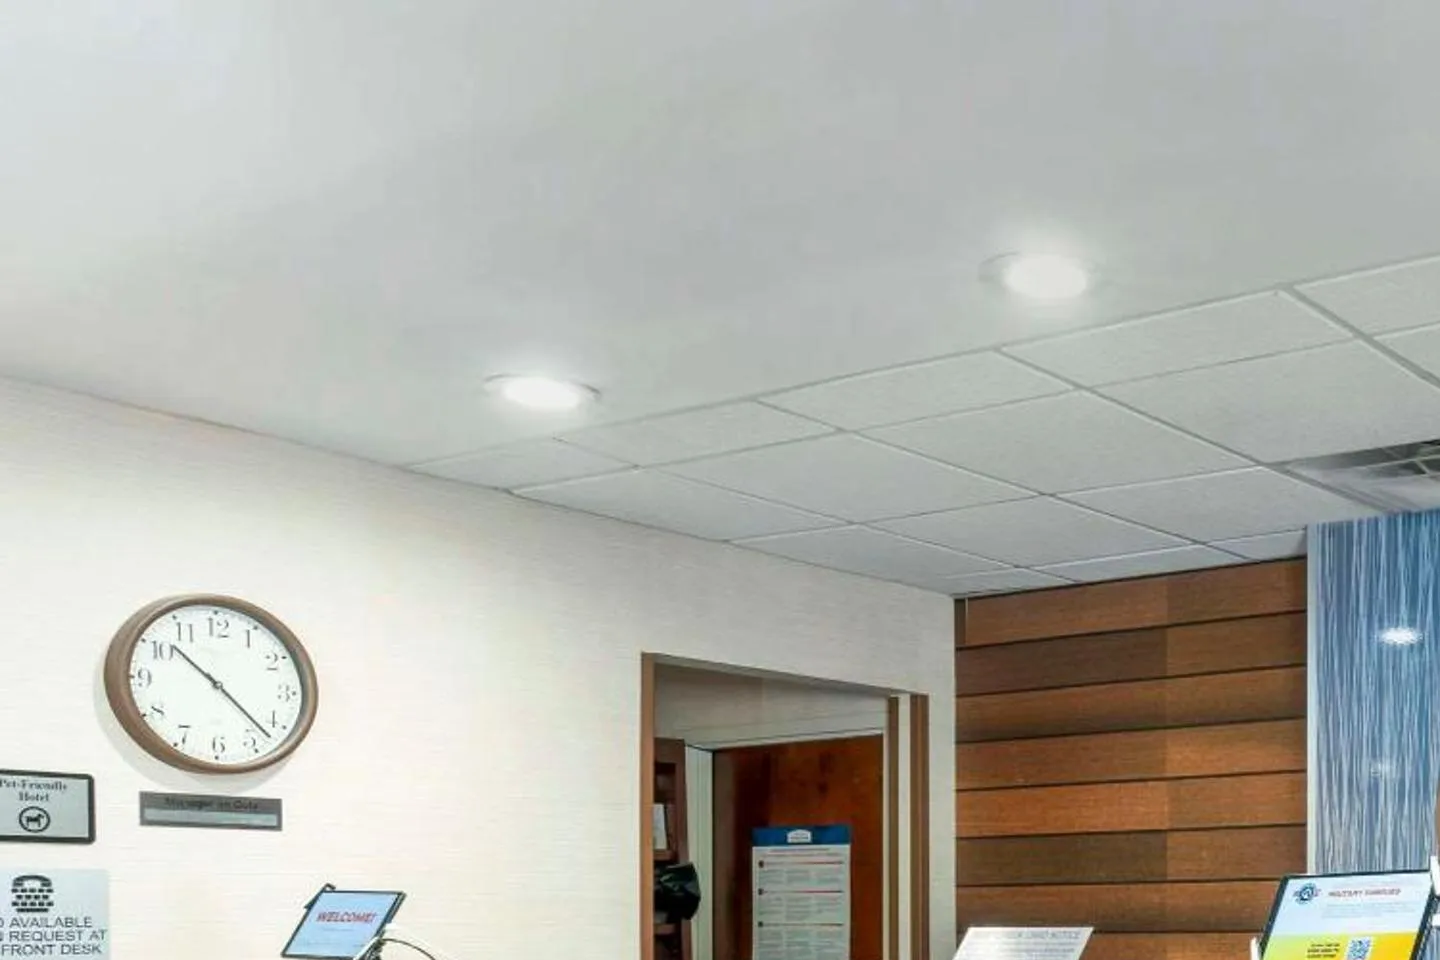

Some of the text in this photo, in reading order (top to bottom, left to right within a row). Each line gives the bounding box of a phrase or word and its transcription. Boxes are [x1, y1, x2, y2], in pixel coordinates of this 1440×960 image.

[177, 622, 194, 643] 11
[208, 617, 230, 638] 12
[245, 629, 251, 648] 1
[152, 641, 174, 661] 10
[265, 652, 279, 671] 2
[137, 667, 152, 688] 9
[277, 685, 291, 702] 3
[265, 710, 278, 728] 4
[178, 725, 192, 745] 7
[212, 736, 226, 753] 6
[18, 791, 51, 802] Hotel
[9, 916, 93, 928] AVAILABLE
[9, 930, 84, 942] REQUEST
[89, 929, 108, 940] AT
[1, 944, 103, 956] FRONT DESK
